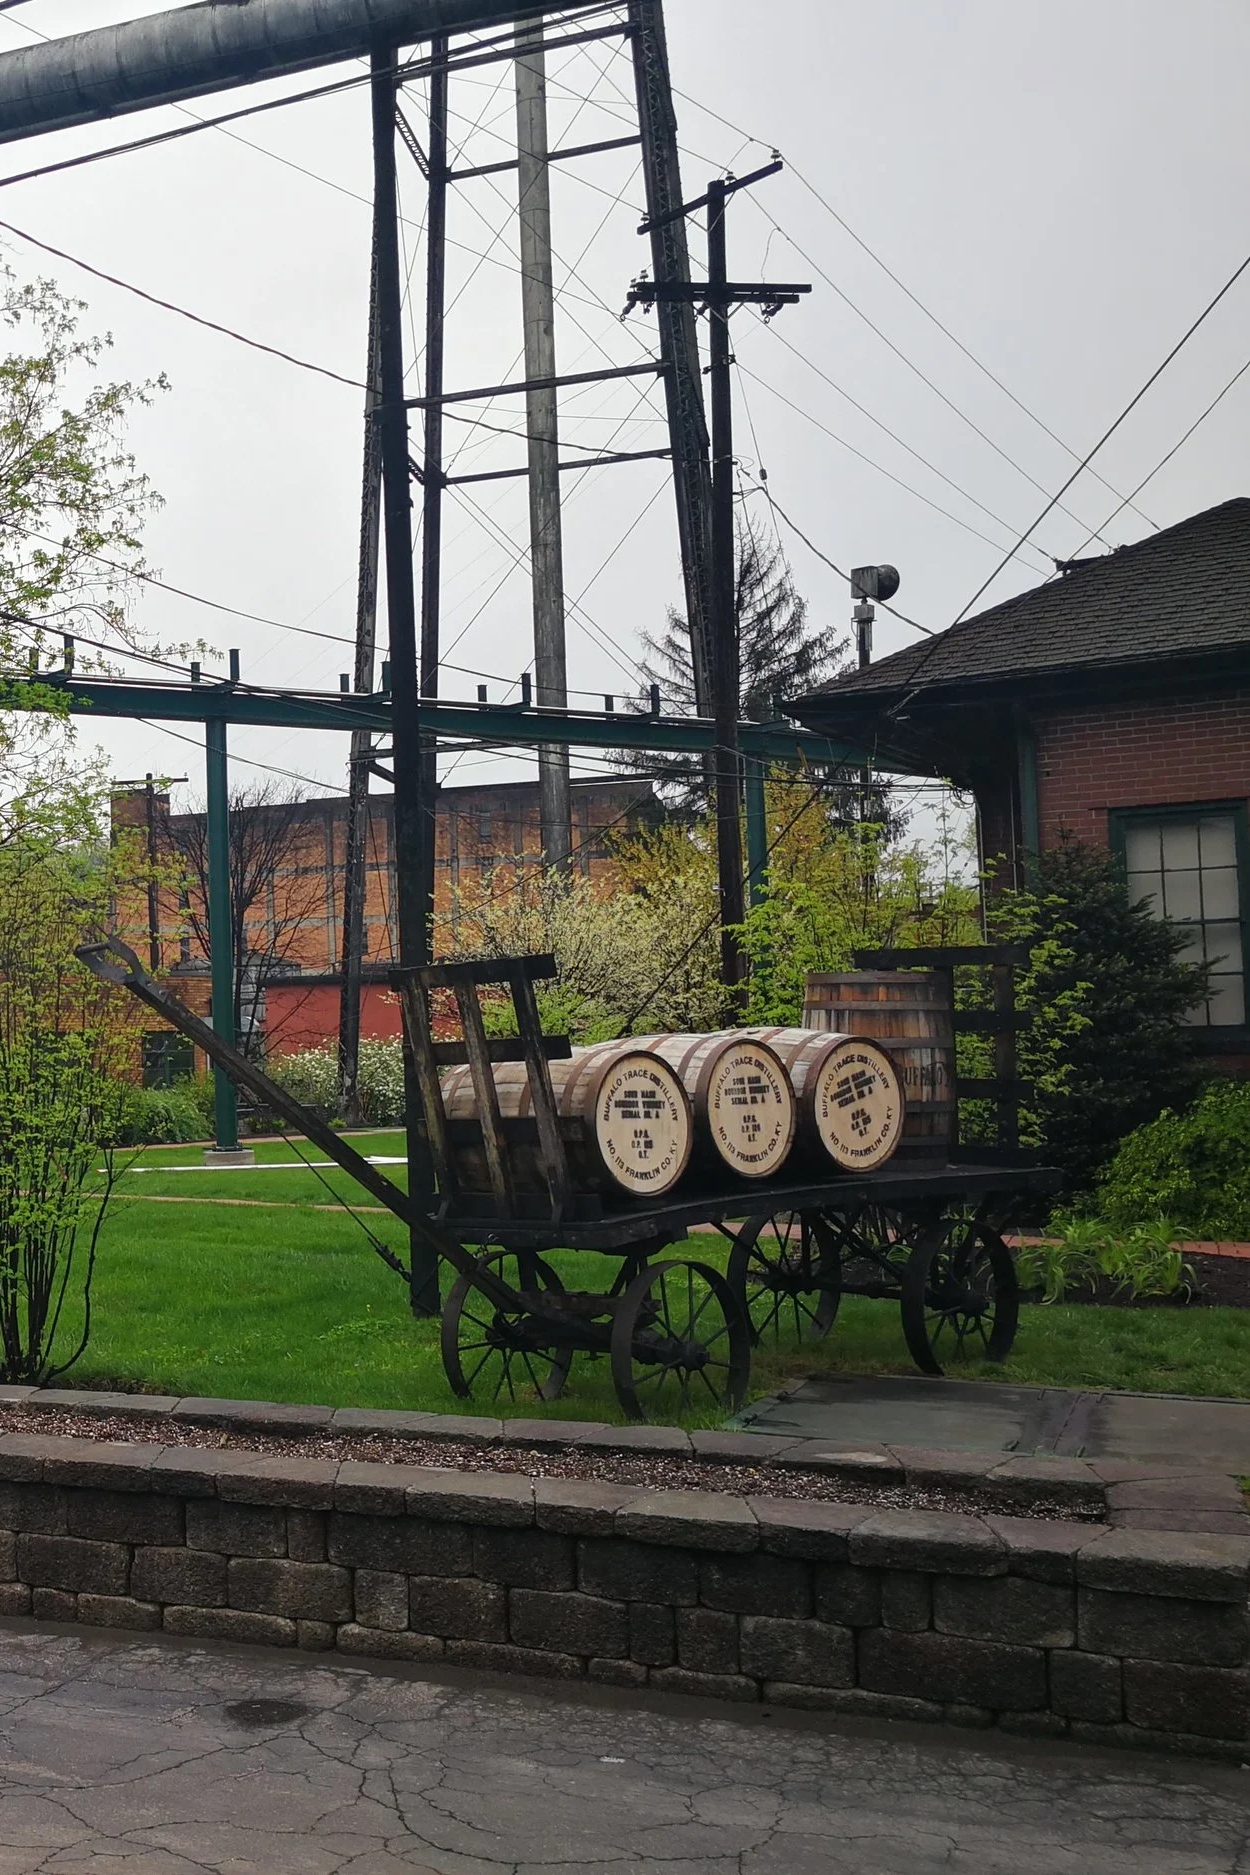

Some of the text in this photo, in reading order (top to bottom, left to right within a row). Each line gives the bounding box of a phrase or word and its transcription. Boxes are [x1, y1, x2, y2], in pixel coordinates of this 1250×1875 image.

[604, 1069, 678, 1122] BUFFALO TRACE DISTILLERY
[715, 1056, 782, 1109] BUFFALO TRACE DISTILLERY
[822, 1055, 889, 1118] BUFFALO TRACE DISTILLERY
[719, 1121, 782, 1162] NO. 113 FRANKLIN CO. KY
[830, 1106, 893, 1157] NO. 113 FRANKLIN CO. KY
[607, 1139, 677, 1180] NO. 113 FRANKLIN CO. KY
